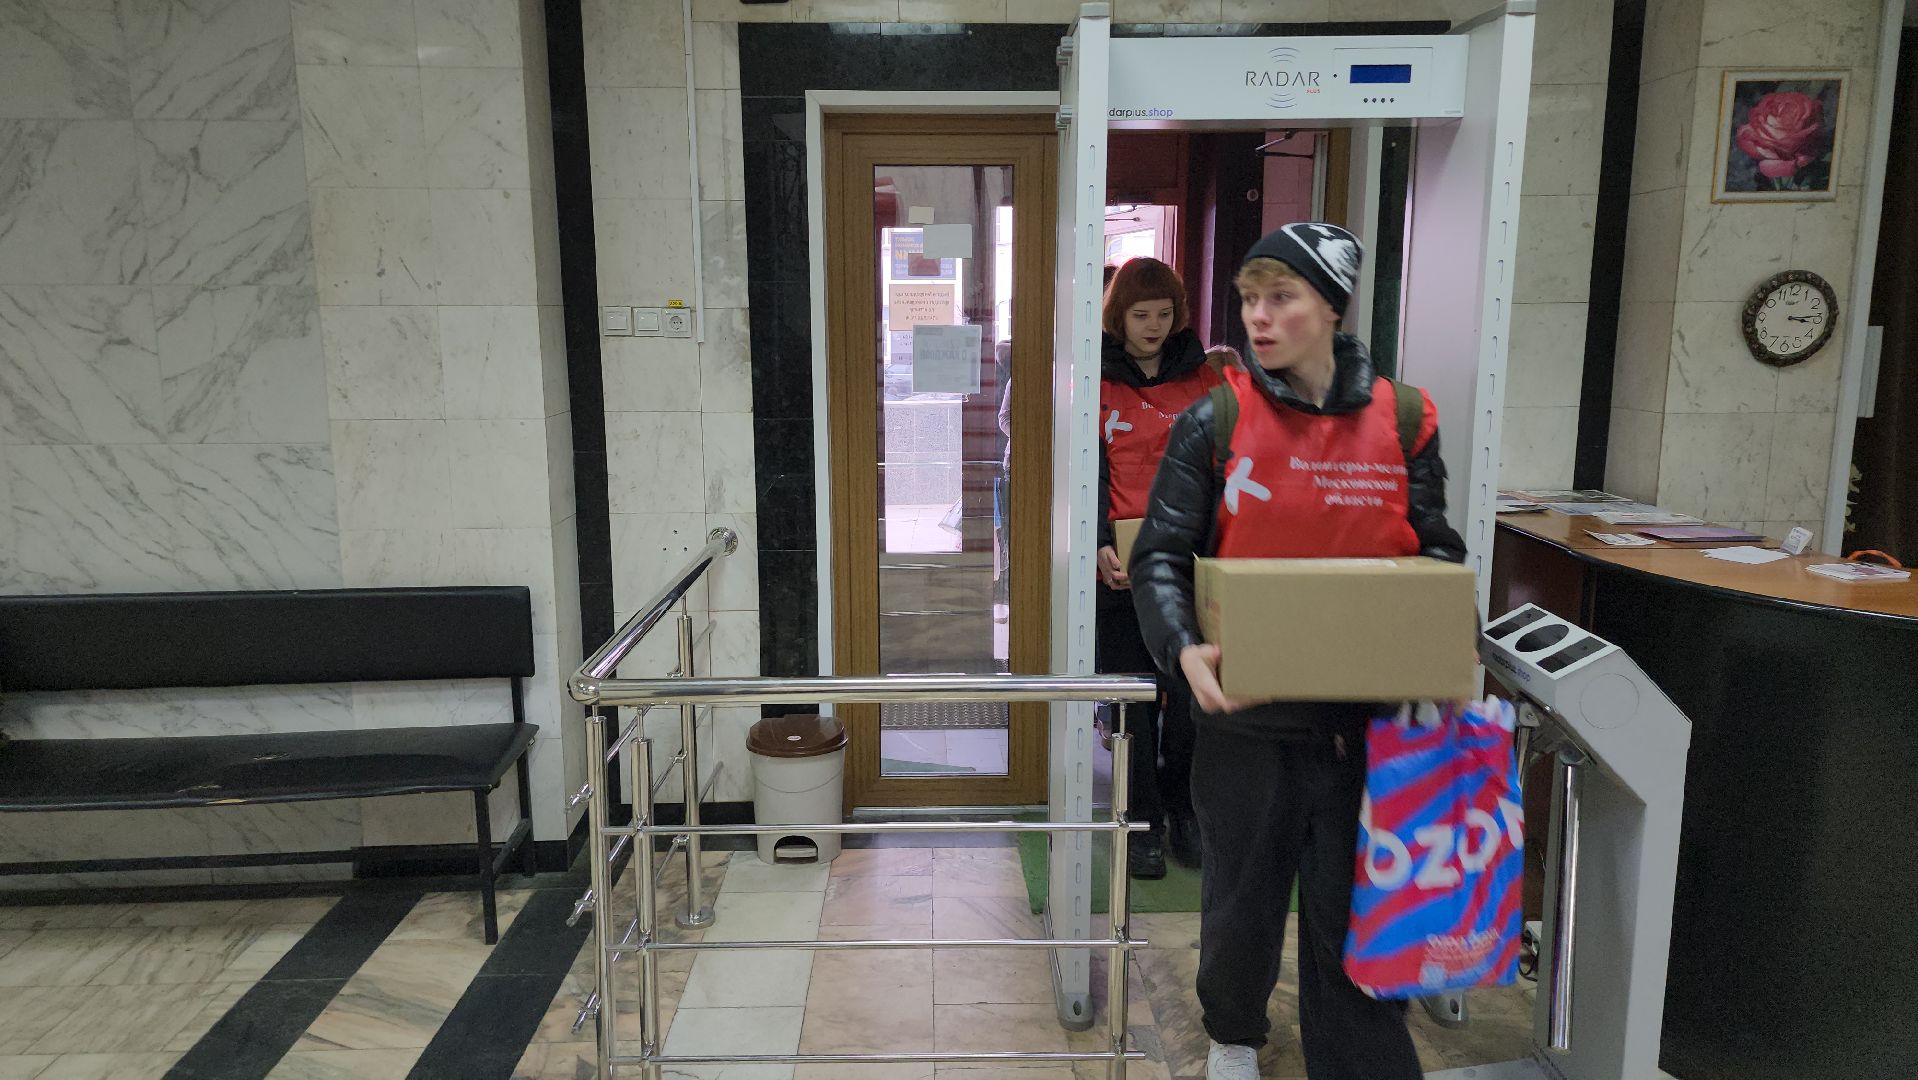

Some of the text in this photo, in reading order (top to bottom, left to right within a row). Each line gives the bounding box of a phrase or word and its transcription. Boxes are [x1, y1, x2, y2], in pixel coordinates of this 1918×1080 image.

[1245, 71, 1320, 87] RADAR
[1108, 107, 1174, 118] darplus.shop
[1779, 289, 1788, 301] 11
[1790, 284, 1801, 296] 12
[1805, 289, 1809, 301] 1
[1810, 298, 1820, 309] 2
[1759, 312, 1766, 323] 9
[1813, 312, 1823, 324] 3
[1760, 326, 1768, 339] 8
[1804, 328, 1814, 339] 4
[1770, 336, 1779, 347] 7
[1780, 340, 1789, 352] 6
[1792, 337, 1801, 348] 5
